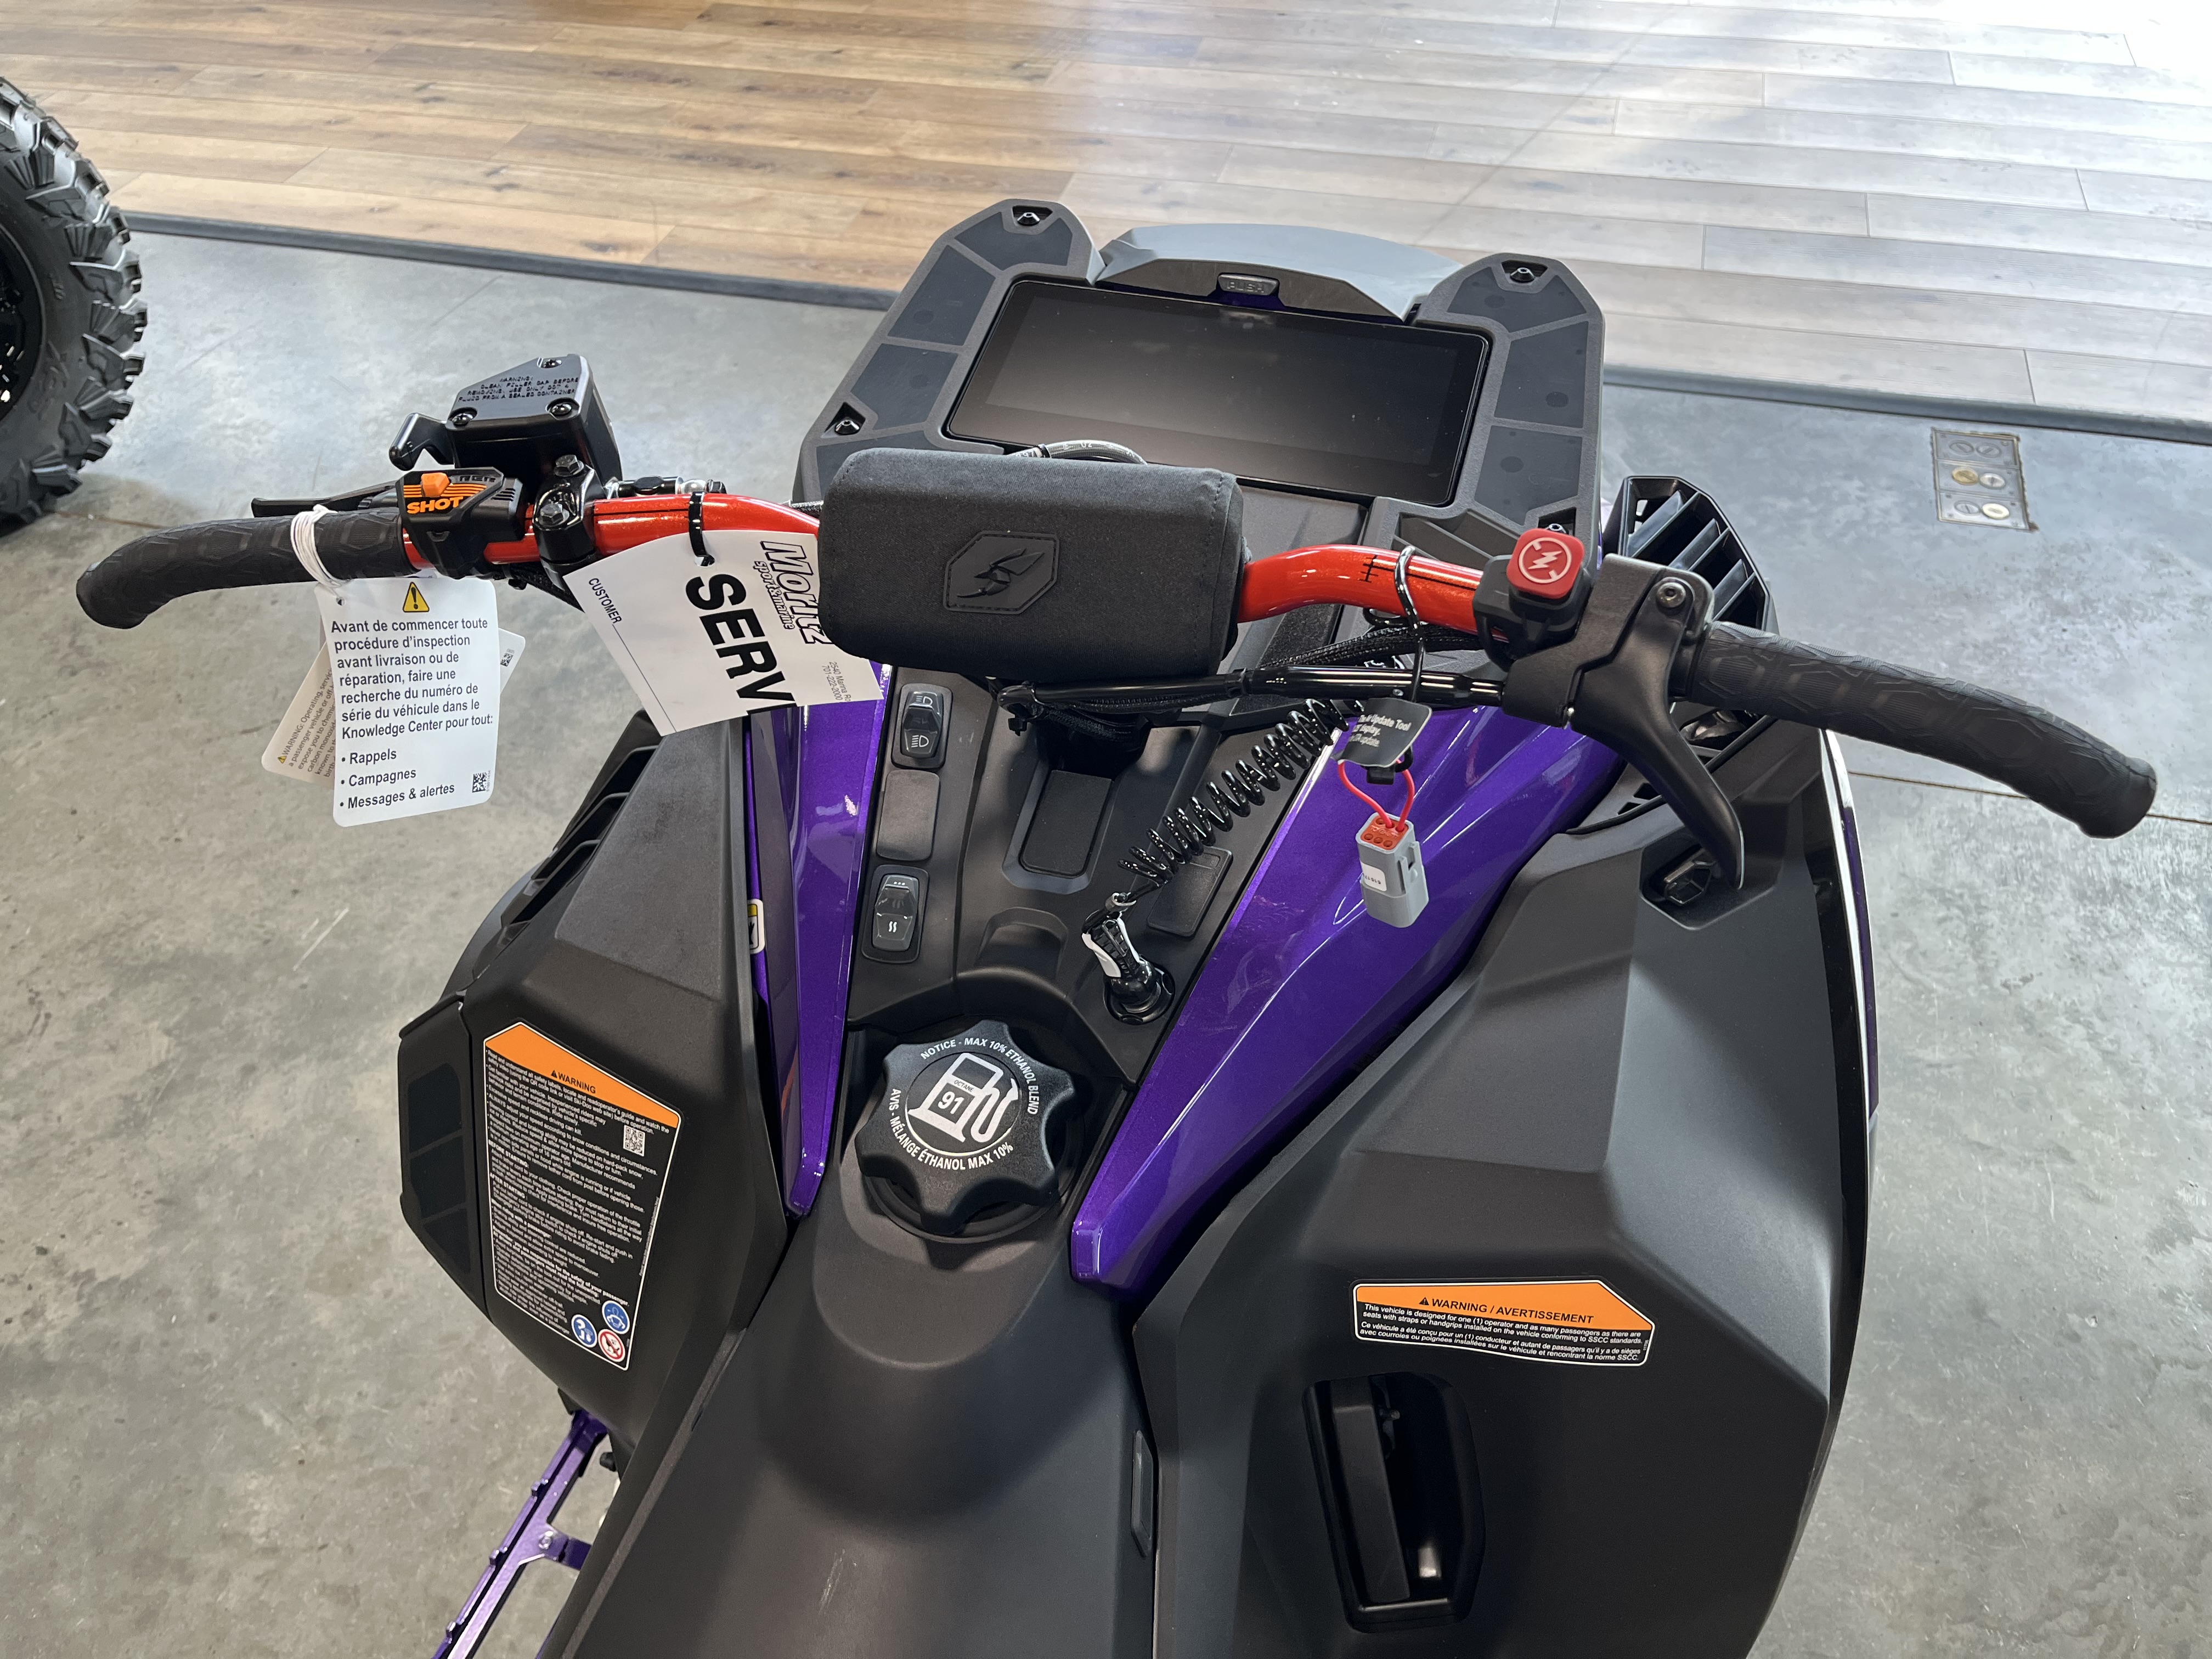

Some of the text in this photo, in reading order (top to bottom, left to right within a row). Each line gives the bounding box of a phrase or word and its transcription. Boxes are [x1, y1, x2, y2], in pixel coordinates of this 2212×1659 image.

[407, 496, 464, 514] SHOT
[589, 578, 622, 624] CUSTOMER
[753, 561, 795, 629] sport&marine
[760, 541, 834, 644] Moritz
[331, 618, 487, 633] Avant de commencer toute
[334, 636, 398, 653] procédure
[337, 651, 459, 668] avant livraison ou de
[340, 669, 455, 687] réparation, faire une
[822, 665, 843, 701] 701-222-2000
[829, 662, 841, 675] 2540
[836, 676, 847, 693] Marina
[341, 689, 400, 704] recherche
[404, 687, 417, 699] du
[422, 684, 462, 697] numéro
[466, 682, 478, 694] de
[342, 698, 479, 721] série du véhicule dans le
[291, 730, 311, 762] passenger
[308, 707, 324, 729] vehicle
[321, 698, 328, 707] or
[342, 714, 492, 739] Knowledge Center pour tout:
[1395, 719, 1412, 731] Tool
[298, 747, 313, 769] expose
[310, 735, 320, 747] you
[307, 751, 322, 772] carbon
[314, 754, 330, 775] known
[349, 748, 396, 765] Rappels
[348, 770, 416, 786] Campagnes
[348, 784, 454, 809] Messages & alertes
[557, 1071, 596, 1094] WARNING
[920, 1037, 1040, 1115] NOTICE MAX 10% ETHANOL BLEND
[953, 1079, 974, 1093] OCTANE
[938, 1091, 966, 1115] 91
[888, 1088, 1014, 1170] AVIS MÉLANGE ÉTHANOL MAX 10%
[1364, 1303, 1379, 1311] This
[1414, 1310, 1446, 1319] designed
[1560, 1328, 1600, 1336] passengers
[1432, 1298, 1594, 1323] WARNING / AVERTISSEMENT
[1372, 1323, 1399, 1331] véhicule
[1475, 1335, 1511, 1344] conducteur
[1620, 1347, 1640, 1356] sièges
[1428, 1317, 1462, 1329] handgrips
[1463, 1323, 1492, 1331] installed
[1541, 1333, 1578, 1342] conforming
[1421, 1334, 1452, 1342] poignées
[1454, 1338, 1486, 1347] installées
[1509, 1346, 1537, 1355] véhicule
[1547, 1350, 1585, 1359] rencontrant
